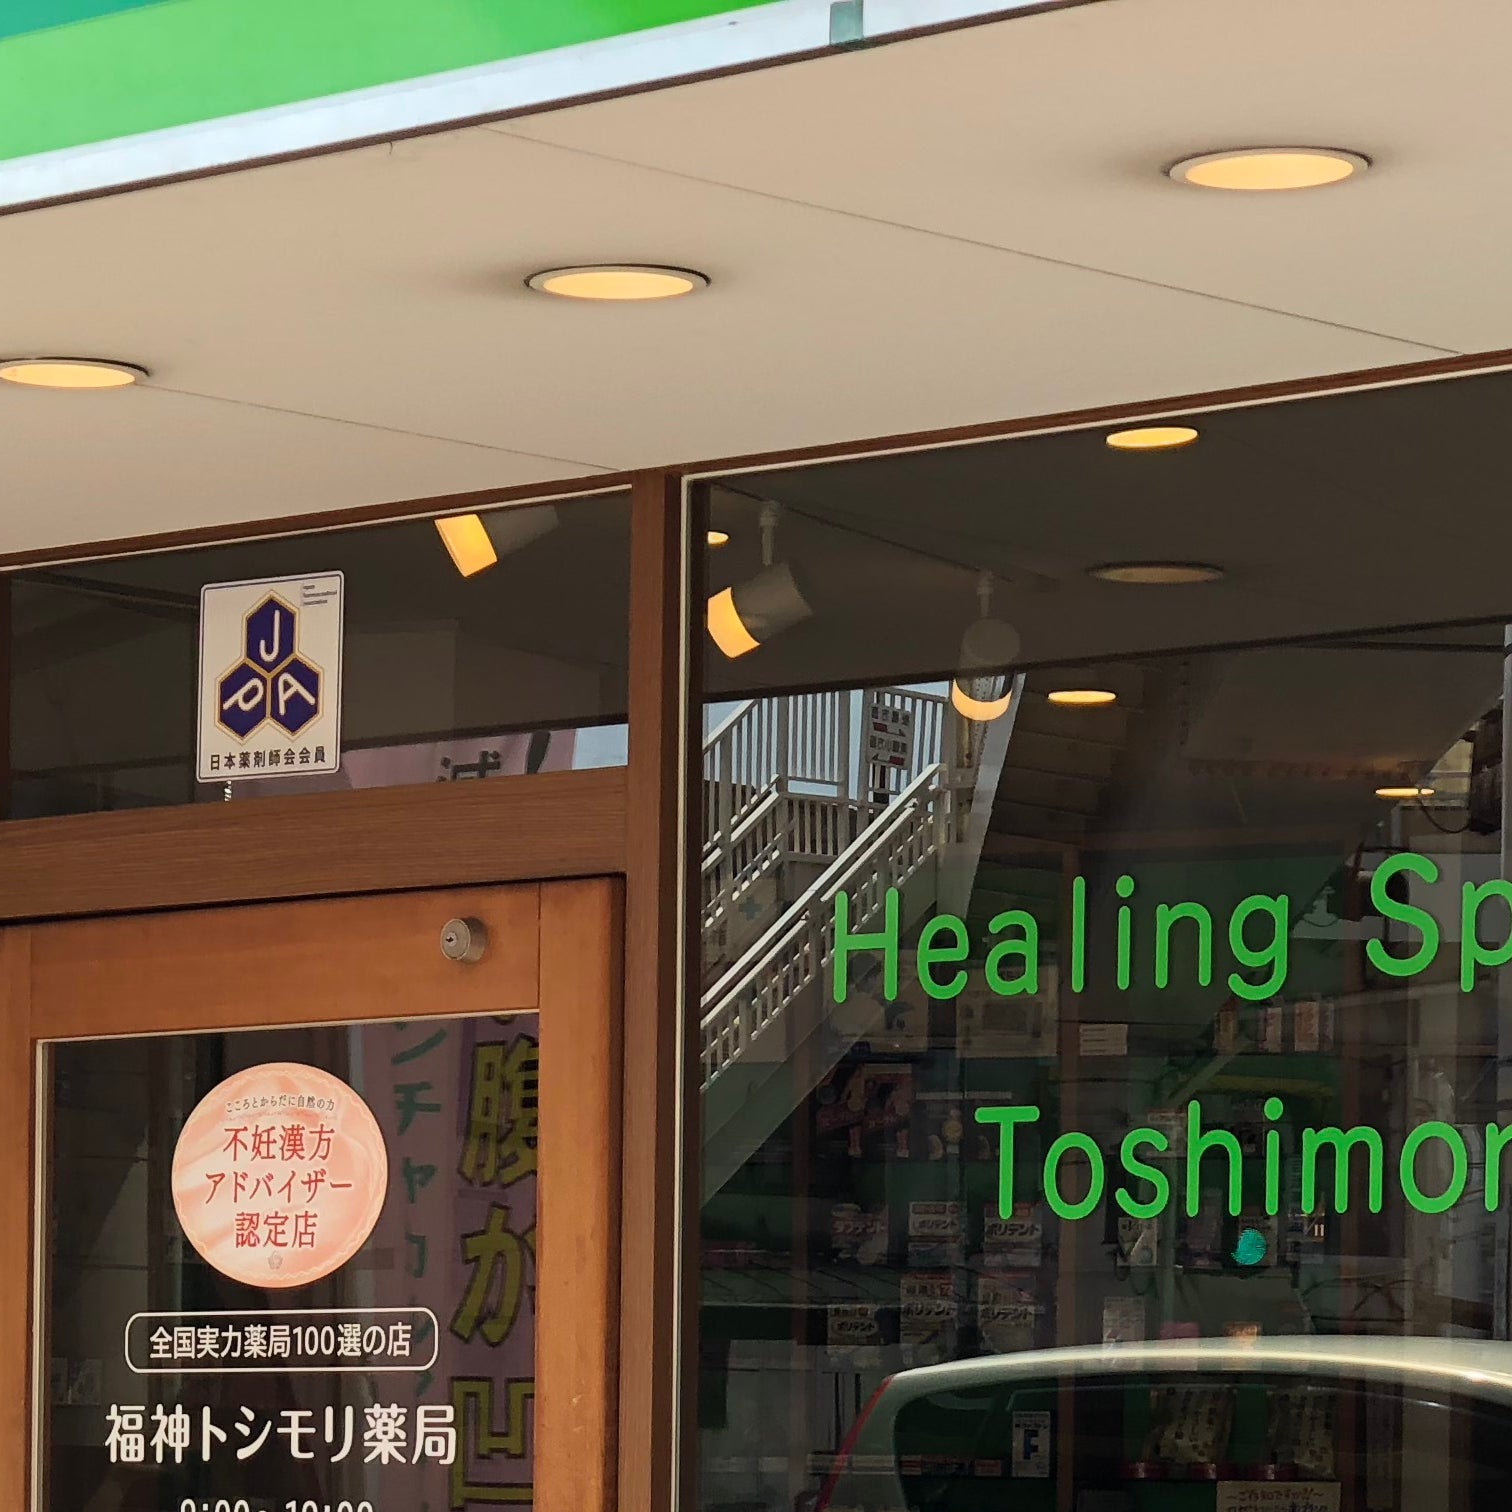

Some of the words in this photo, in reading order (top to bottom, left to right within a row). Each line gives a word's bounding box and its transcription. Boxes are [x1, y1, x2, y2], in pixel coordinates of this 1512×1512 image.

[210, 746, 326, 771] 日本薬剤師会会員
[833, 875, 1288, 1002] Healing
[1367, 852, 1512, 992] Sp
[225, 1093, 335, 1114] こころとからだに自然の力
[222, 1123, 335, 1162] 不妊漢方
[974, 1097, 1512, 1220] Toshimor
[203, 1168, 354, 1204] アドバイザー
[234, 1211, 318, 1250] 認定店
[986, 1222, 1042, 1239] ポリデント
[149, 1322, 413, 1360] 全国実力薬局100選の店
[104, 1402, 457, 1466] 福神トシモリ薬局
